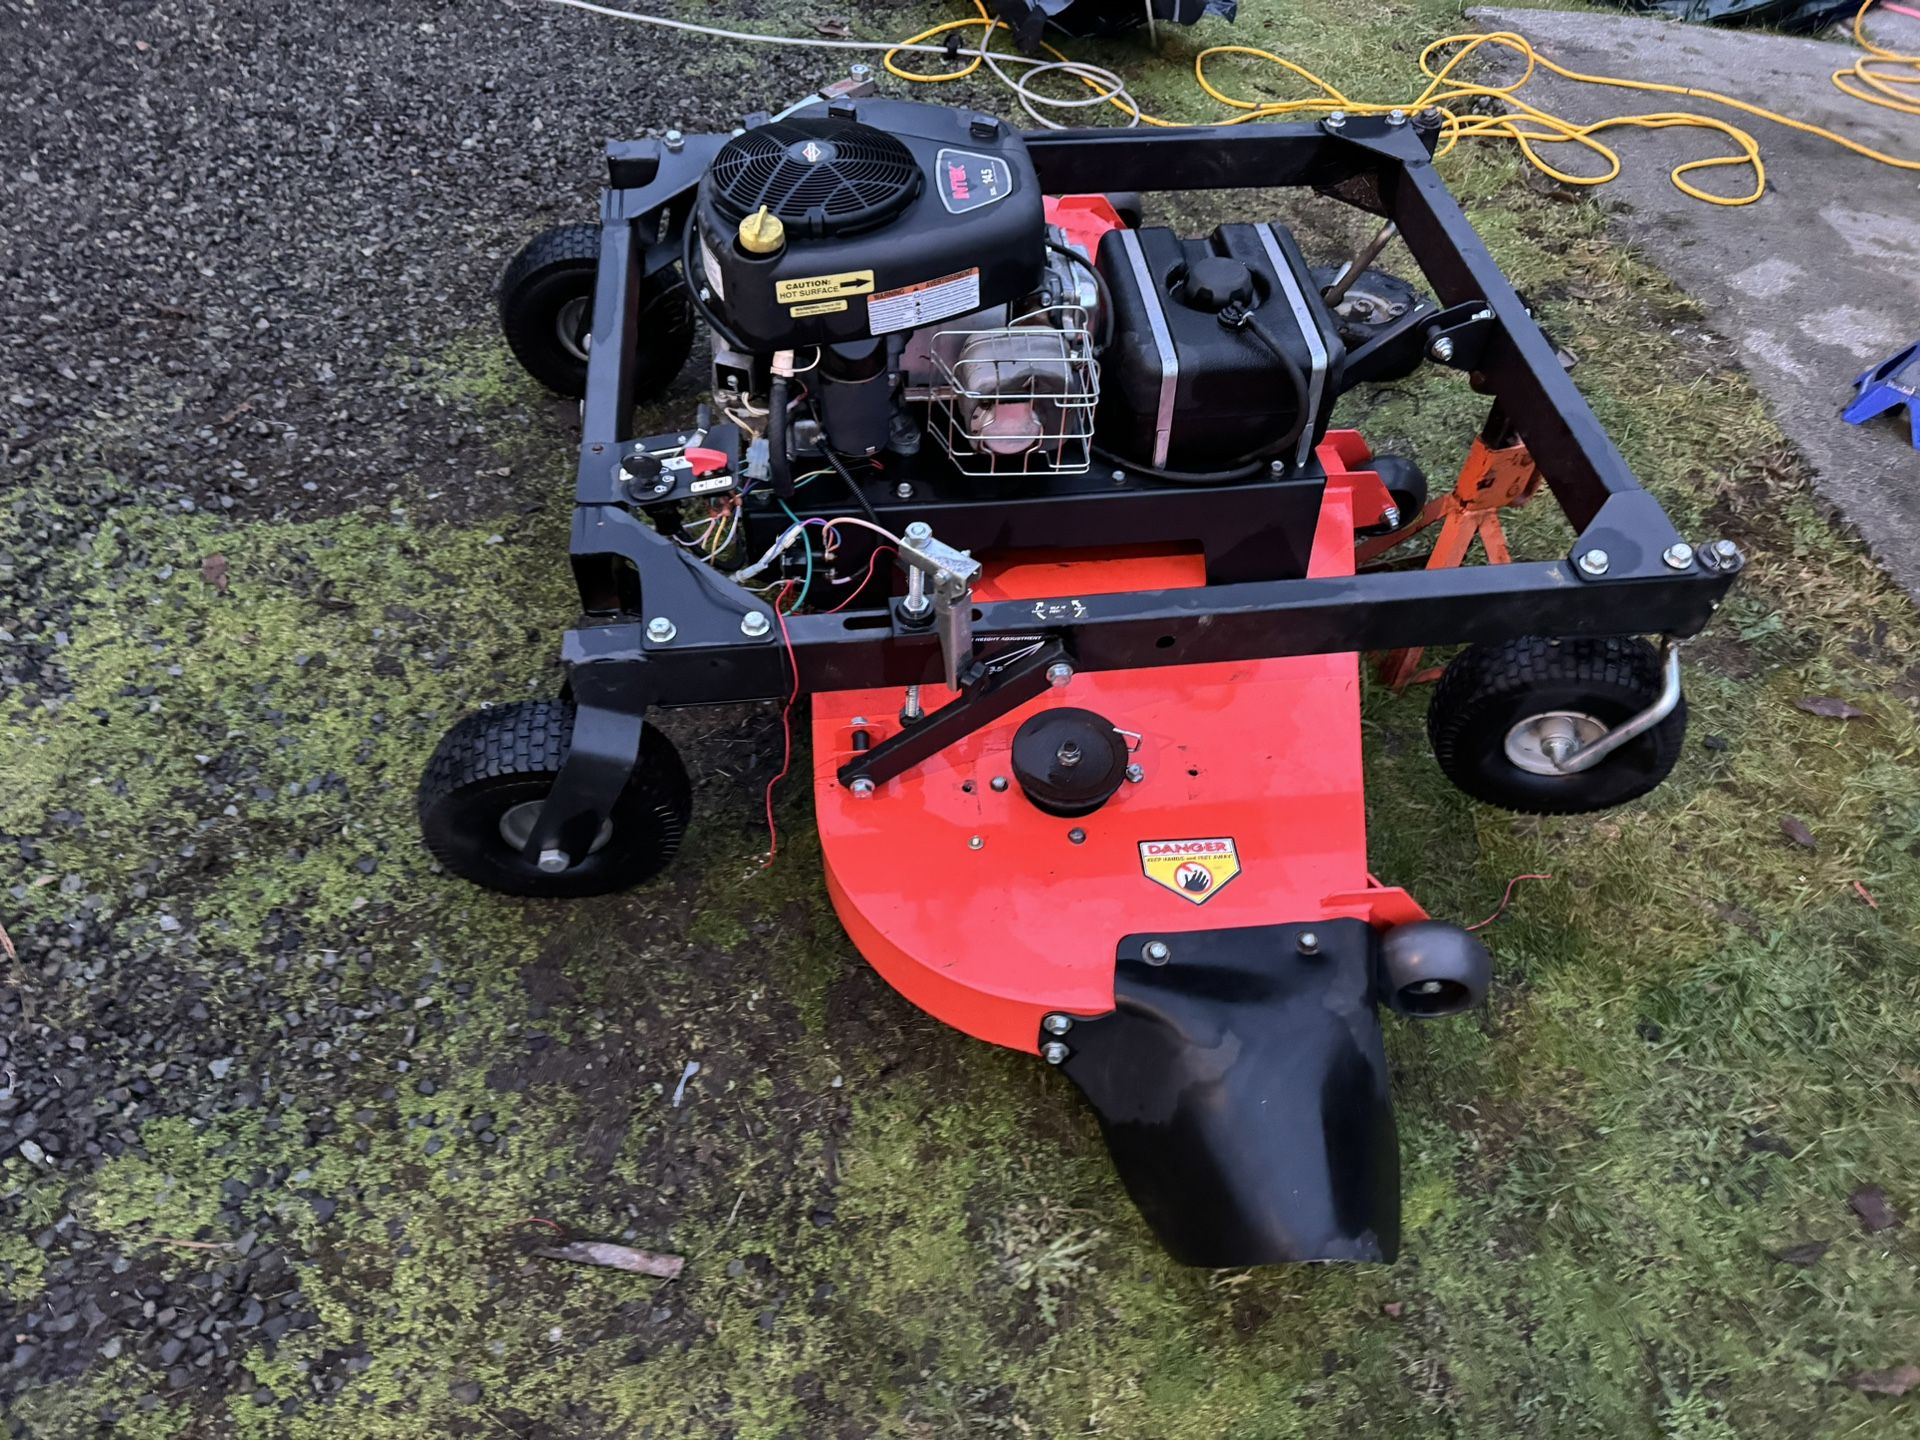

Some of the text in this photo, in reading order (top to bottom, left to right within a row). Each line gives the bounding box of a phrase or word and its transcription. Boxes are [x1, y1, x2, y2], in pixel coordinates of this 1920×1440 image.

[785, 279, 831, 290] CAUTION:
[780, 286, 840, 299] HOT SURFACE
[1147, 842, 1227, 855] DANGER
